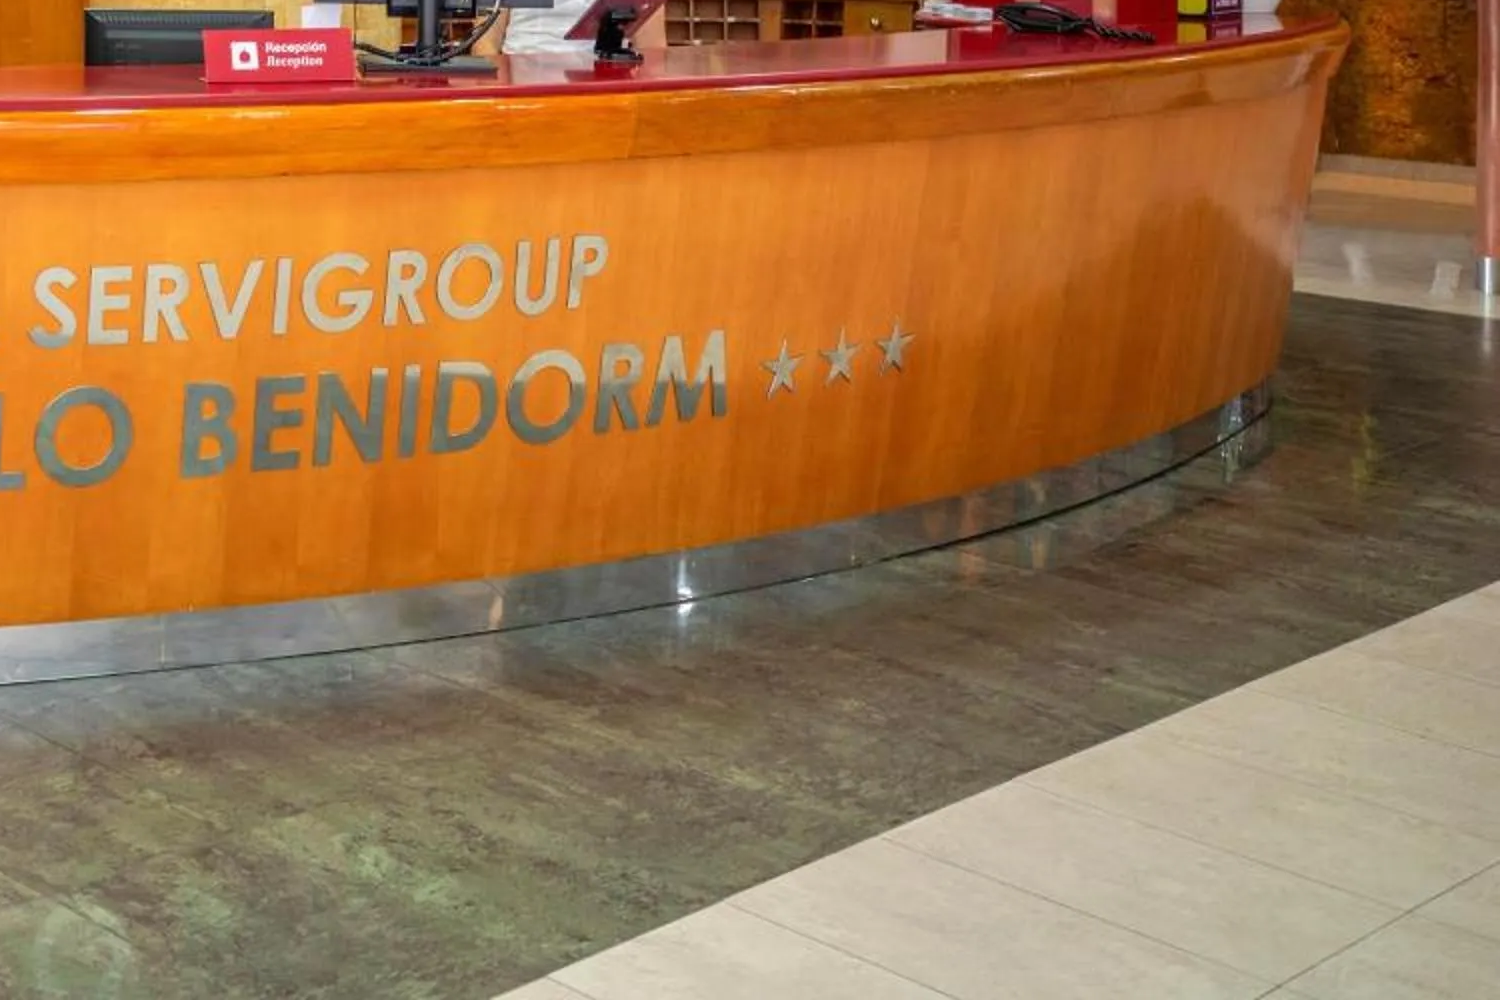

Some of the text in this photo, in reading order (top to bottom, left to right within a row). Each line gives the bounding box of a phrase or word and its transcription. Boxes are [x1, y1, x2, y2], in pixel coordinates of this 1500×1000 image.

[264, 40, 327, 55] Recepción
[267, 55, 323, 68] Reception
[27, 234, 609, 350] SERVIGROUP
[177, 328, 729, 481] BENIDORM
